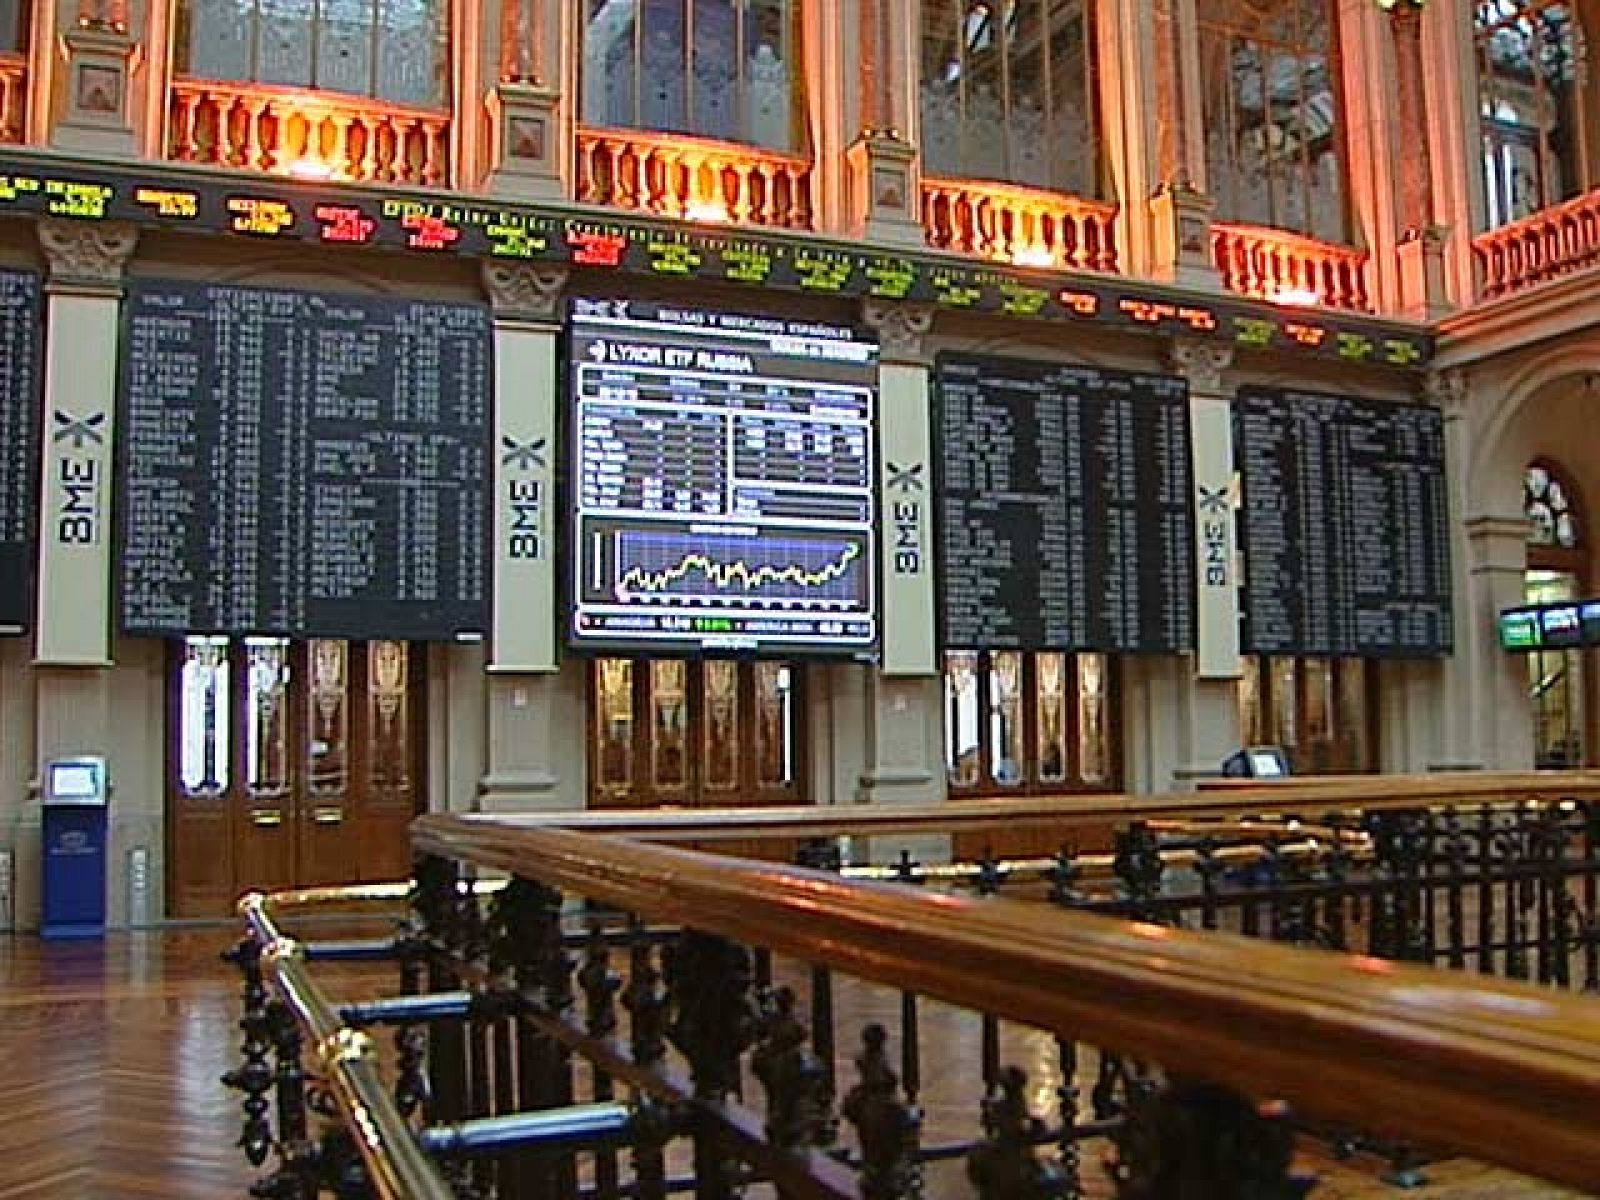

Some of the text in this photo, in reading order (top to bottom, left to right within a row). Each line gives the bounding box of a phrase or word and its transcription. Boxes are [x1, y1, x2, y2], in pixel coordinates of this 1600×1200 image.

[60, 458, 94, 543] BME
[509, 479, 539, 559] BME
[894, 501, 918, 574] BME
[1204, 520, 1226, 586] BME
